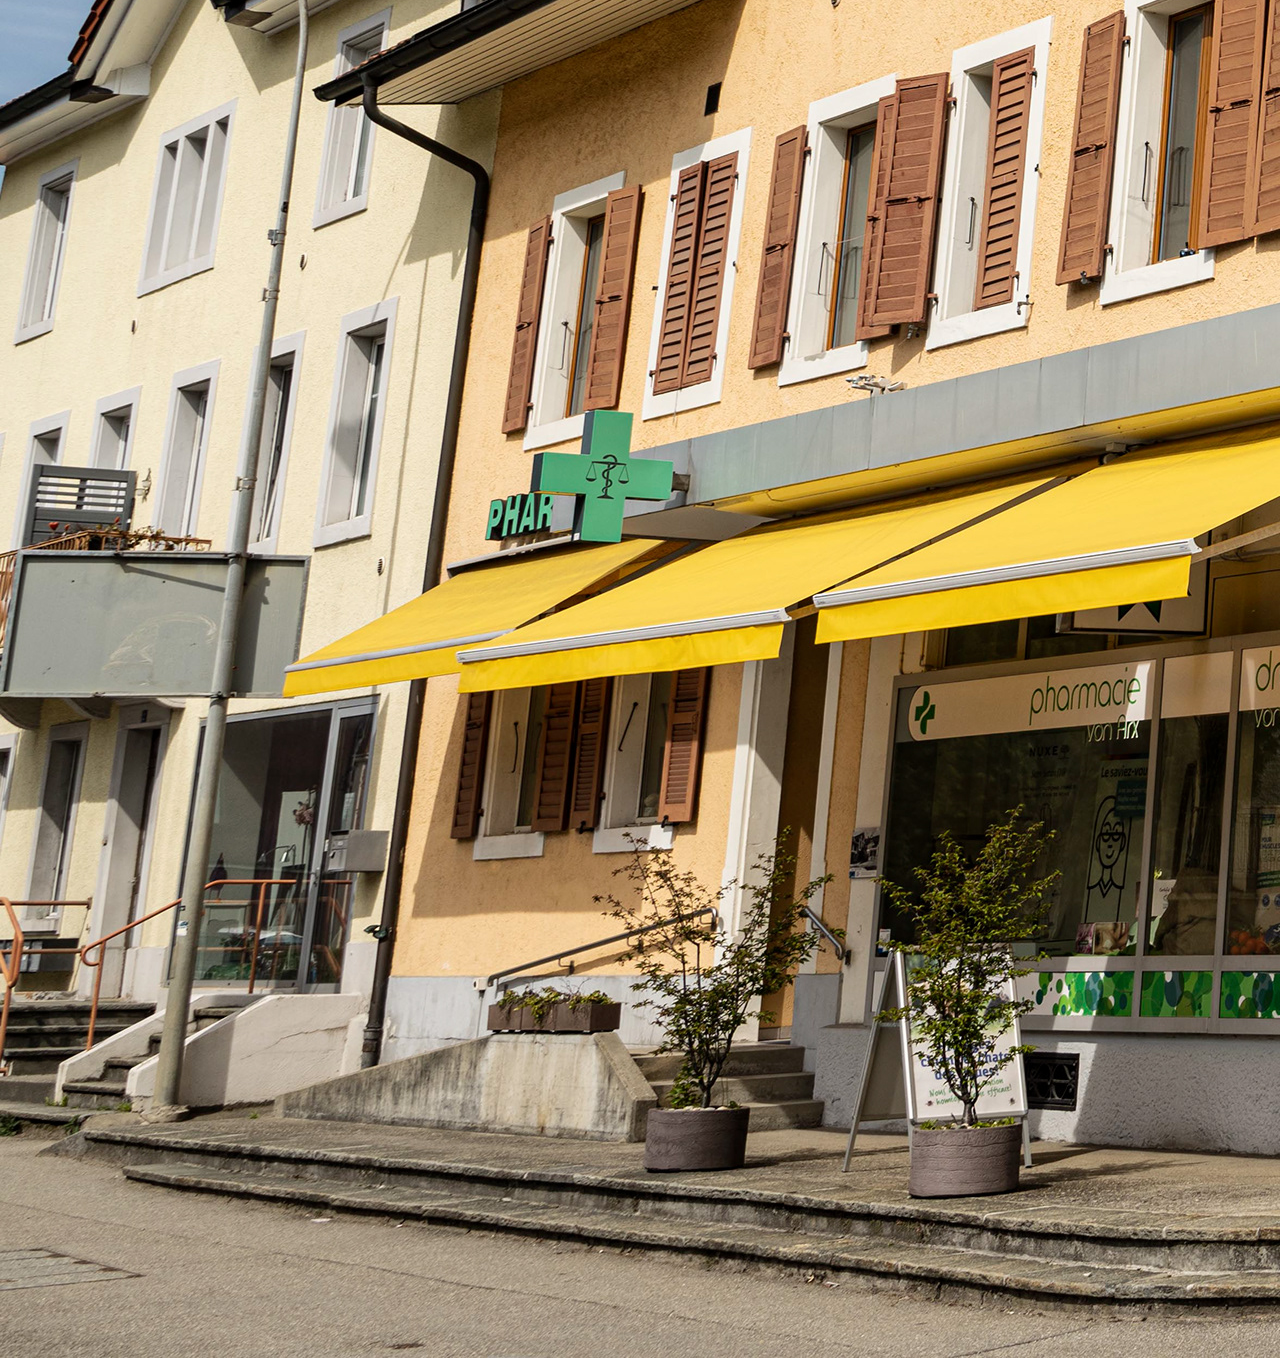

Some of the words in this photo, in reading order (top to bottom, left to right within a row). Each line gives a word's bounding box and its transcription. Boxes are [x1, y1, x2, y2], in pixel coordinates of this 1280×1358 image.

[1028, 666, 1141, 726] pharmacie
[1087, 723, 1113, 742] von
[1116, 714, 1140, 740] Arx
[1029, 745, 1059, 758] NUXE
[1101, 766, 1110, 779] Le
